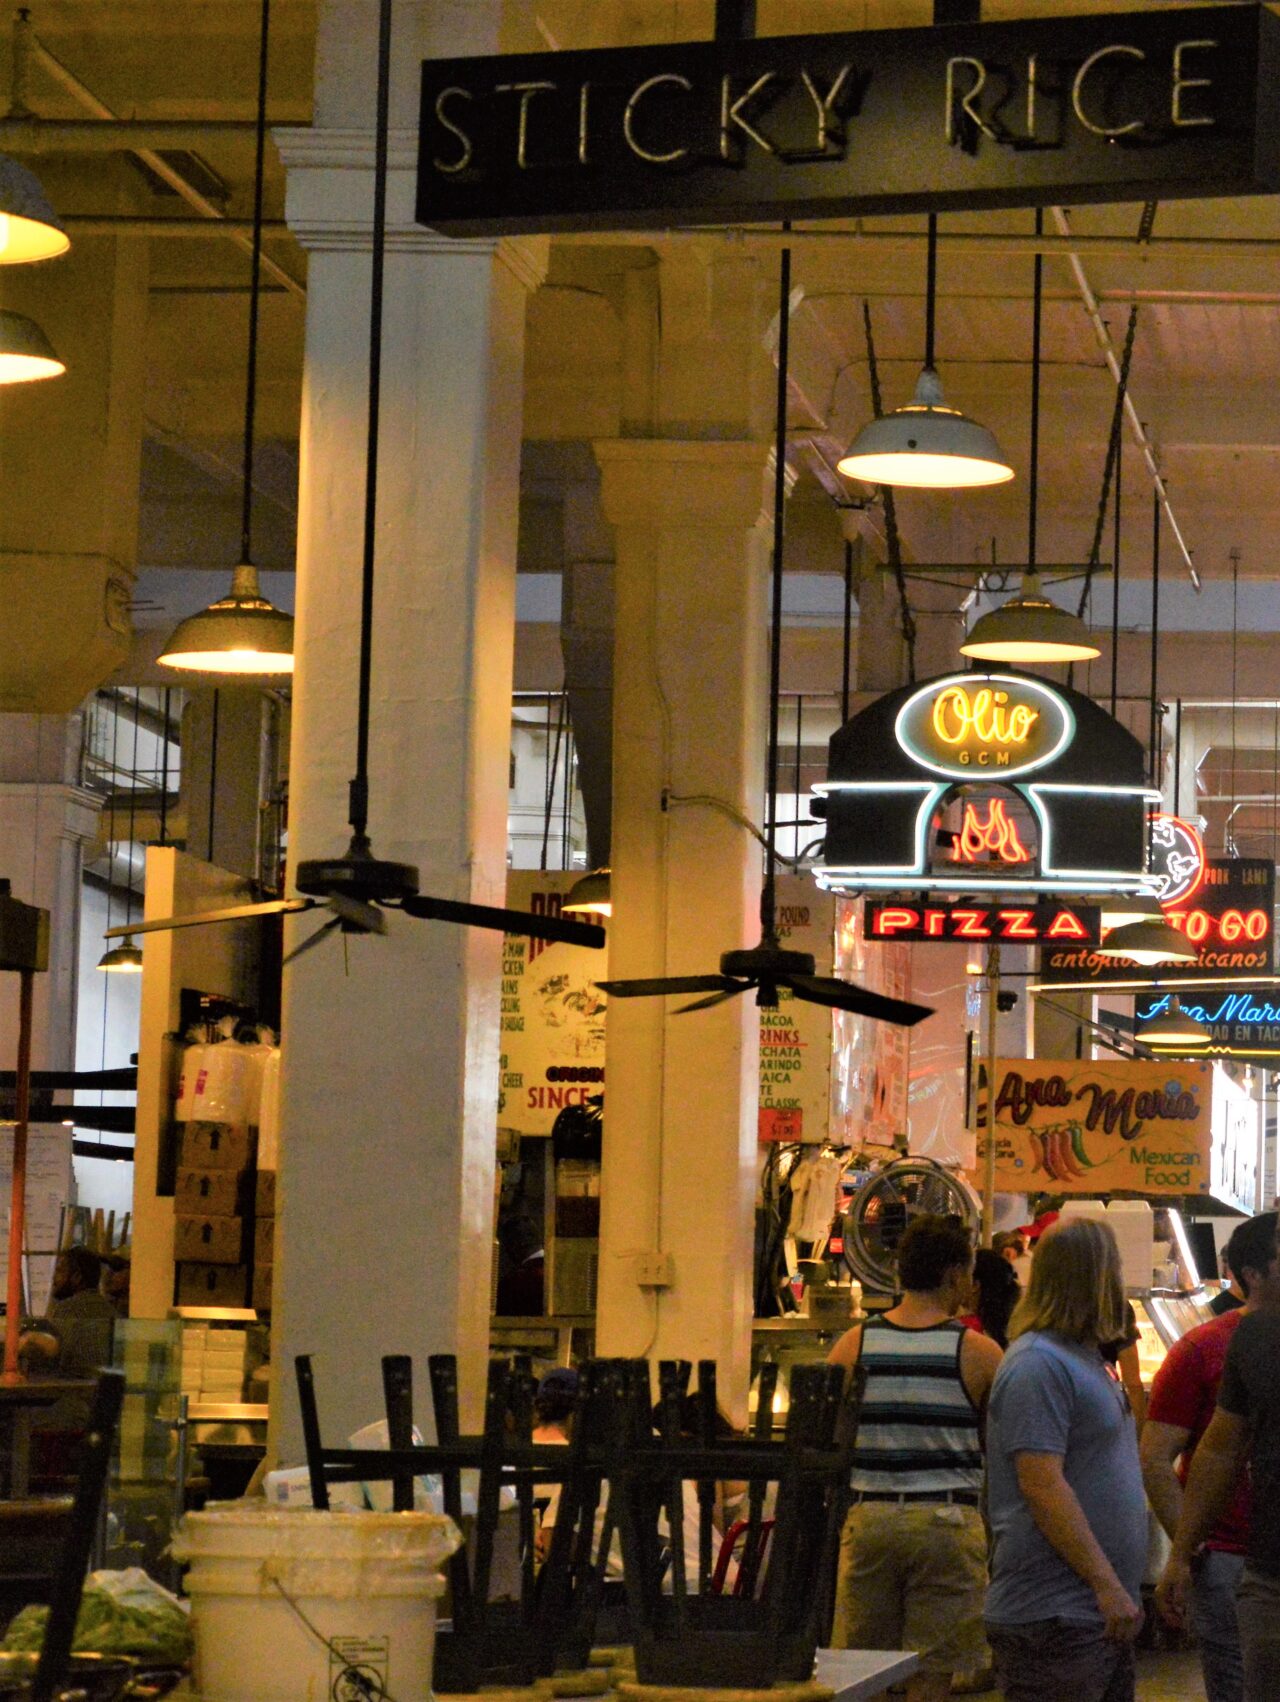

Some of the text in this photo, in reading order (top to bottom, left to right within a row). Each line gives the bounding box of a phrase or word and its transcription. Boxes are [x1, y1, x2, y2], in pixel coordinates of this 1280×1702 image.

[434, 41, 1219, 173] STICKY RICE
[932, 685, 1039, 744] Olio
[780, 906, 810, 922] POUND
[872, 905, 1090, 939] PIZZA
[1219, 909, 1269, 942] GO
[502, 960, 525, 976] CKEN
[759, 1015, 794, 1027] BACOA
[759, 1029, 800, 1044] RINKS
[1235, 1026, 1250, 1041] EN
[760, 1047, 801, 1058] CHATA
[760, 1060, 801, 1071] ARINDO
[762, 1073, 791, 1084] AICA
[995, 1071, 1200, 1140] Ana Maria
[1129, 1147, 1200, 1165] Mexican
[1144, 1166, 1191, 1186] Food
